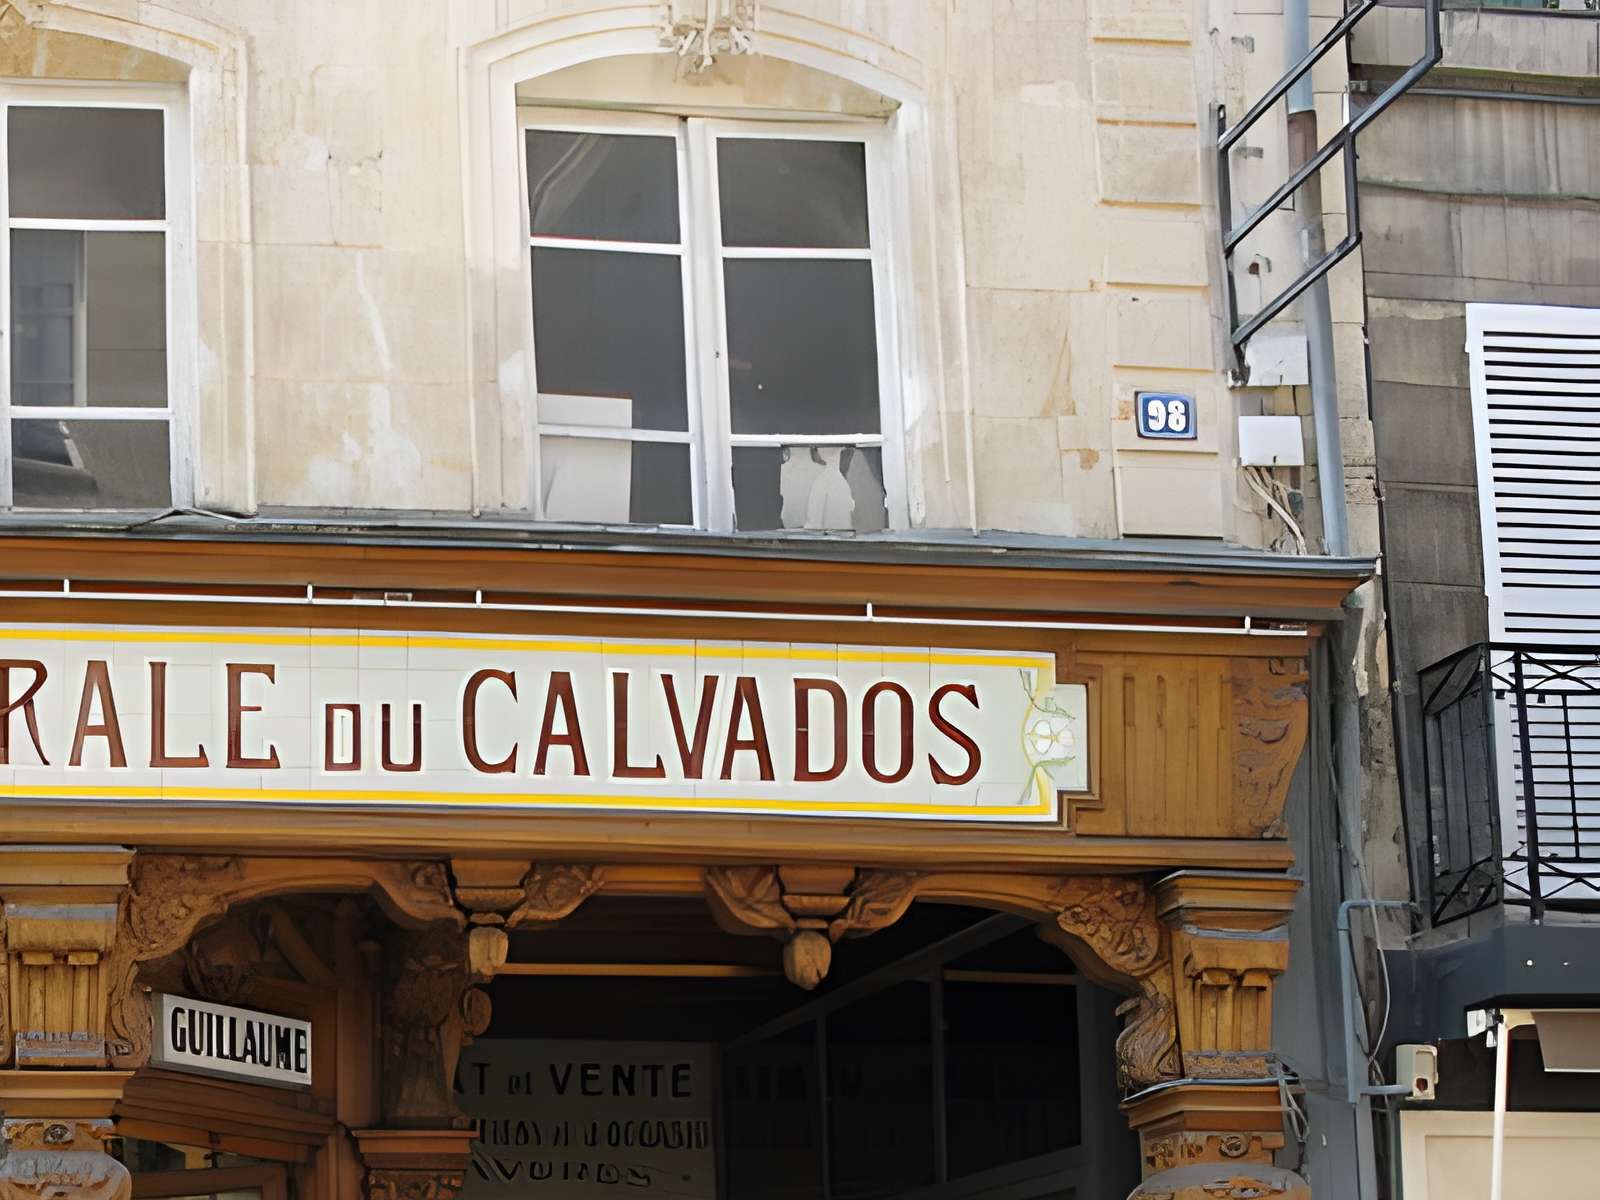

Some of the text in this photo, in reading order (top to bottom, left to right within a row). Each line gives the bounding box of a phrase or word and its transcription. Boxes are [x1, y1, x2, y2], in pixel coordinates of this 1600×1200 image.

[1147, 399, 1187, 432] 98
[324, 702, 423, 772] DU
[462, 668, 983, 786] CALVADOS
[171, 1006, 308, 1074] GUILLAUME
[549, 1062, 691, 1098] VENTE
